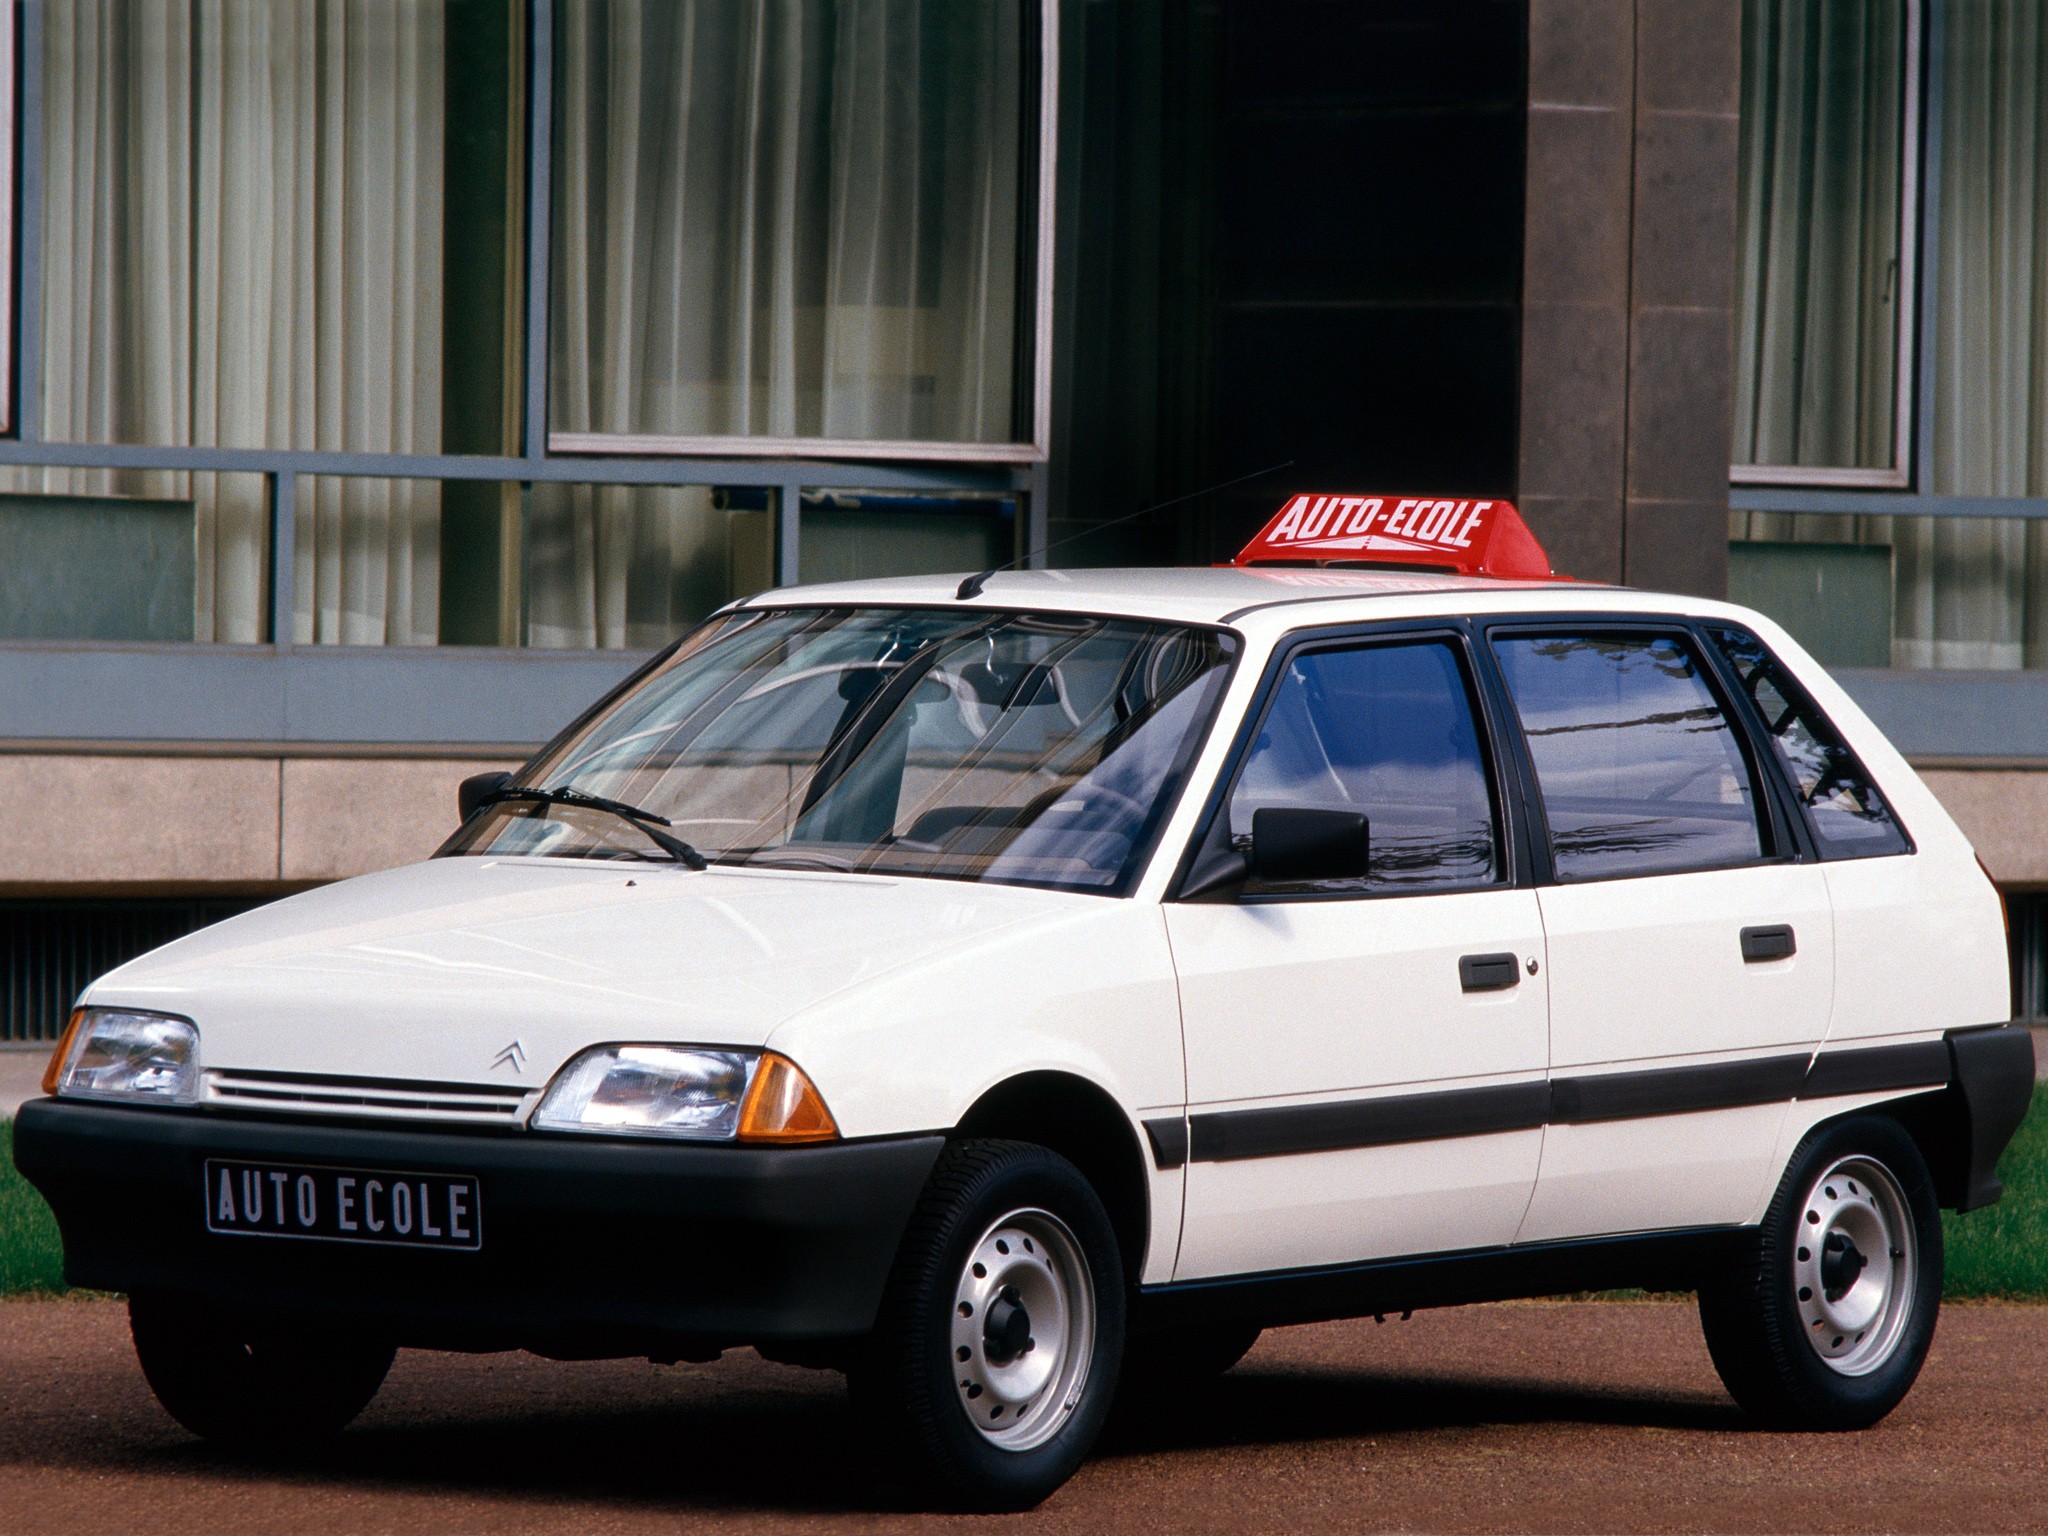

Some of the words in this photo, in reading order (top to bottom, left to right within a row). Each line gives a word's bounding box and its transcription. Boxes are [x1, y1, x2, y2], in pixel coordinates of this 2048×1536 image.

[1266, 496, 1492, 547] AUTO-ECOLE
[218, 1168, 317, 1227] AUTO
[337, 1177, 471, 1238] ECOLE
